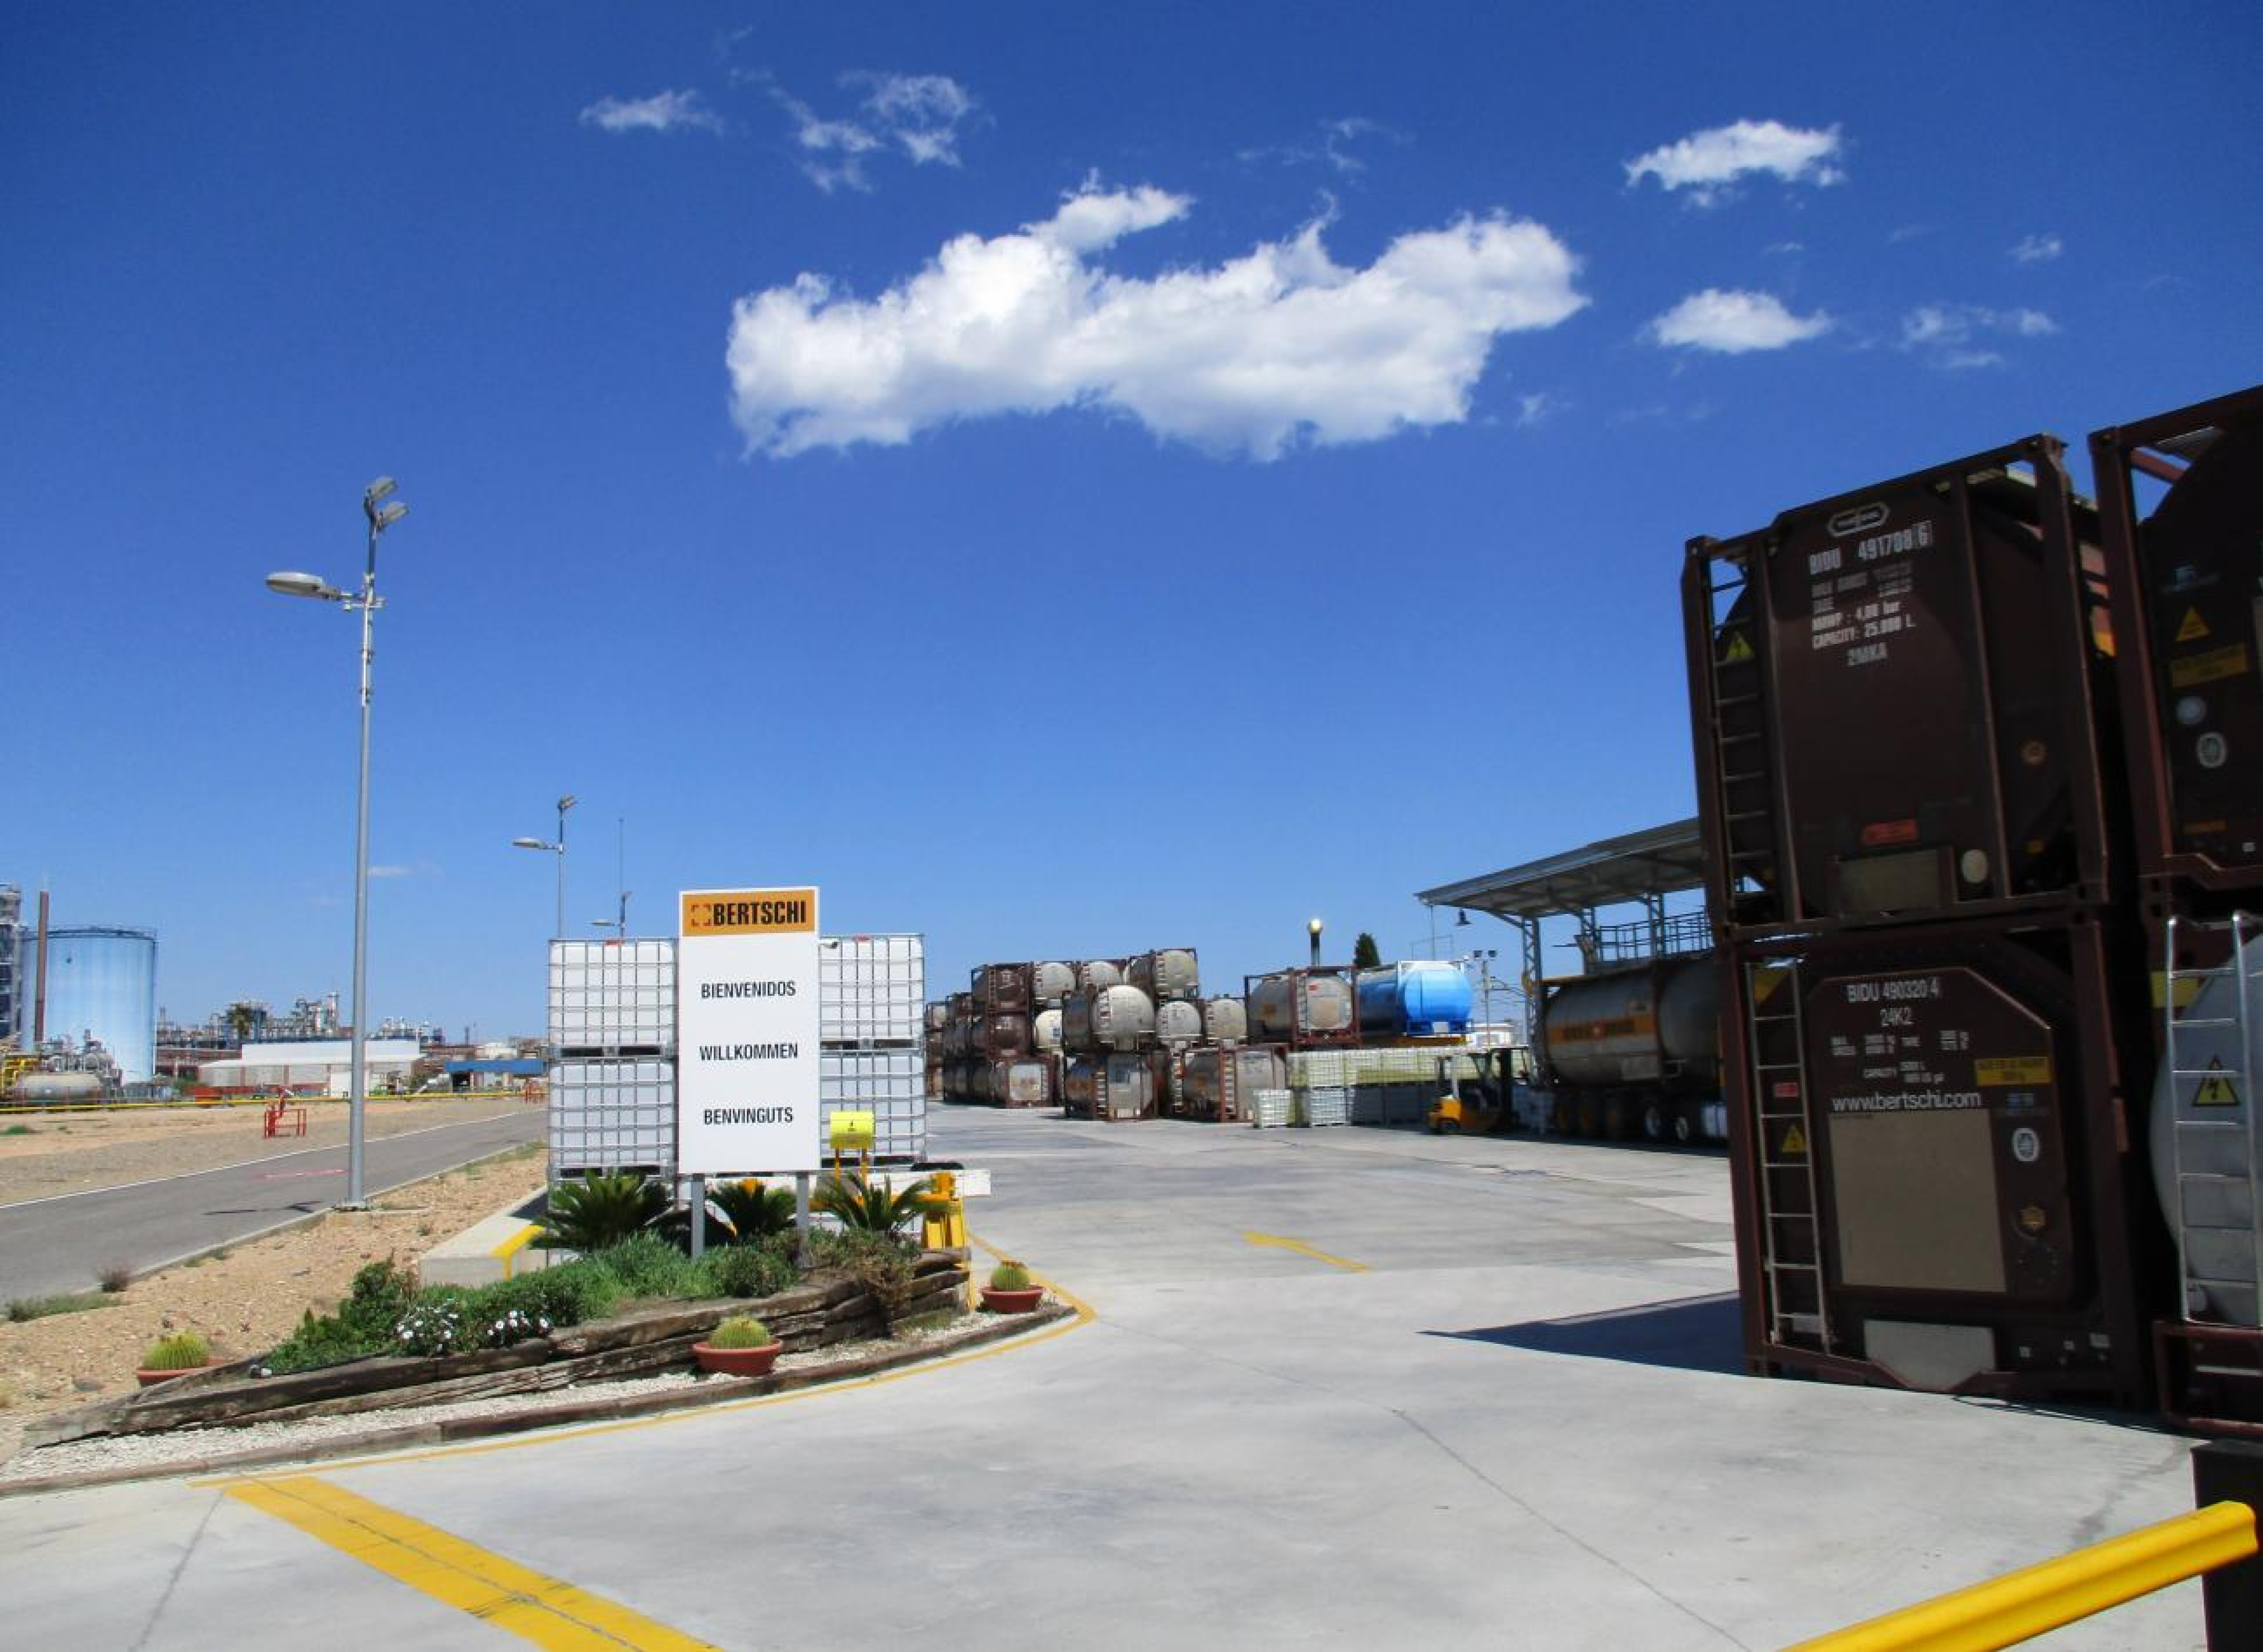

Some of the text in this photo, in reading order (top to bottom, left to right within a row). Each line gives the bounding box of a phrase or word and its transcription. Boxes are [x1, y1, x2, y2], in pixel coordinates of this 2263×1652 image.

[713, 900, 806, 926] BERTSCHI
[701, 981, 796, 999] BIENVENIDOS
[1847, 983, 1879, 1003] BIDU
[1880, 1007, 1914, 1027] 24K2
[699, 1043, 798, 1061] WILLKOMMEN
[1832, 1090, 1981, 1111] www.bertschi.com
[703, 1107, 794, 1125] BENVINGUTS
